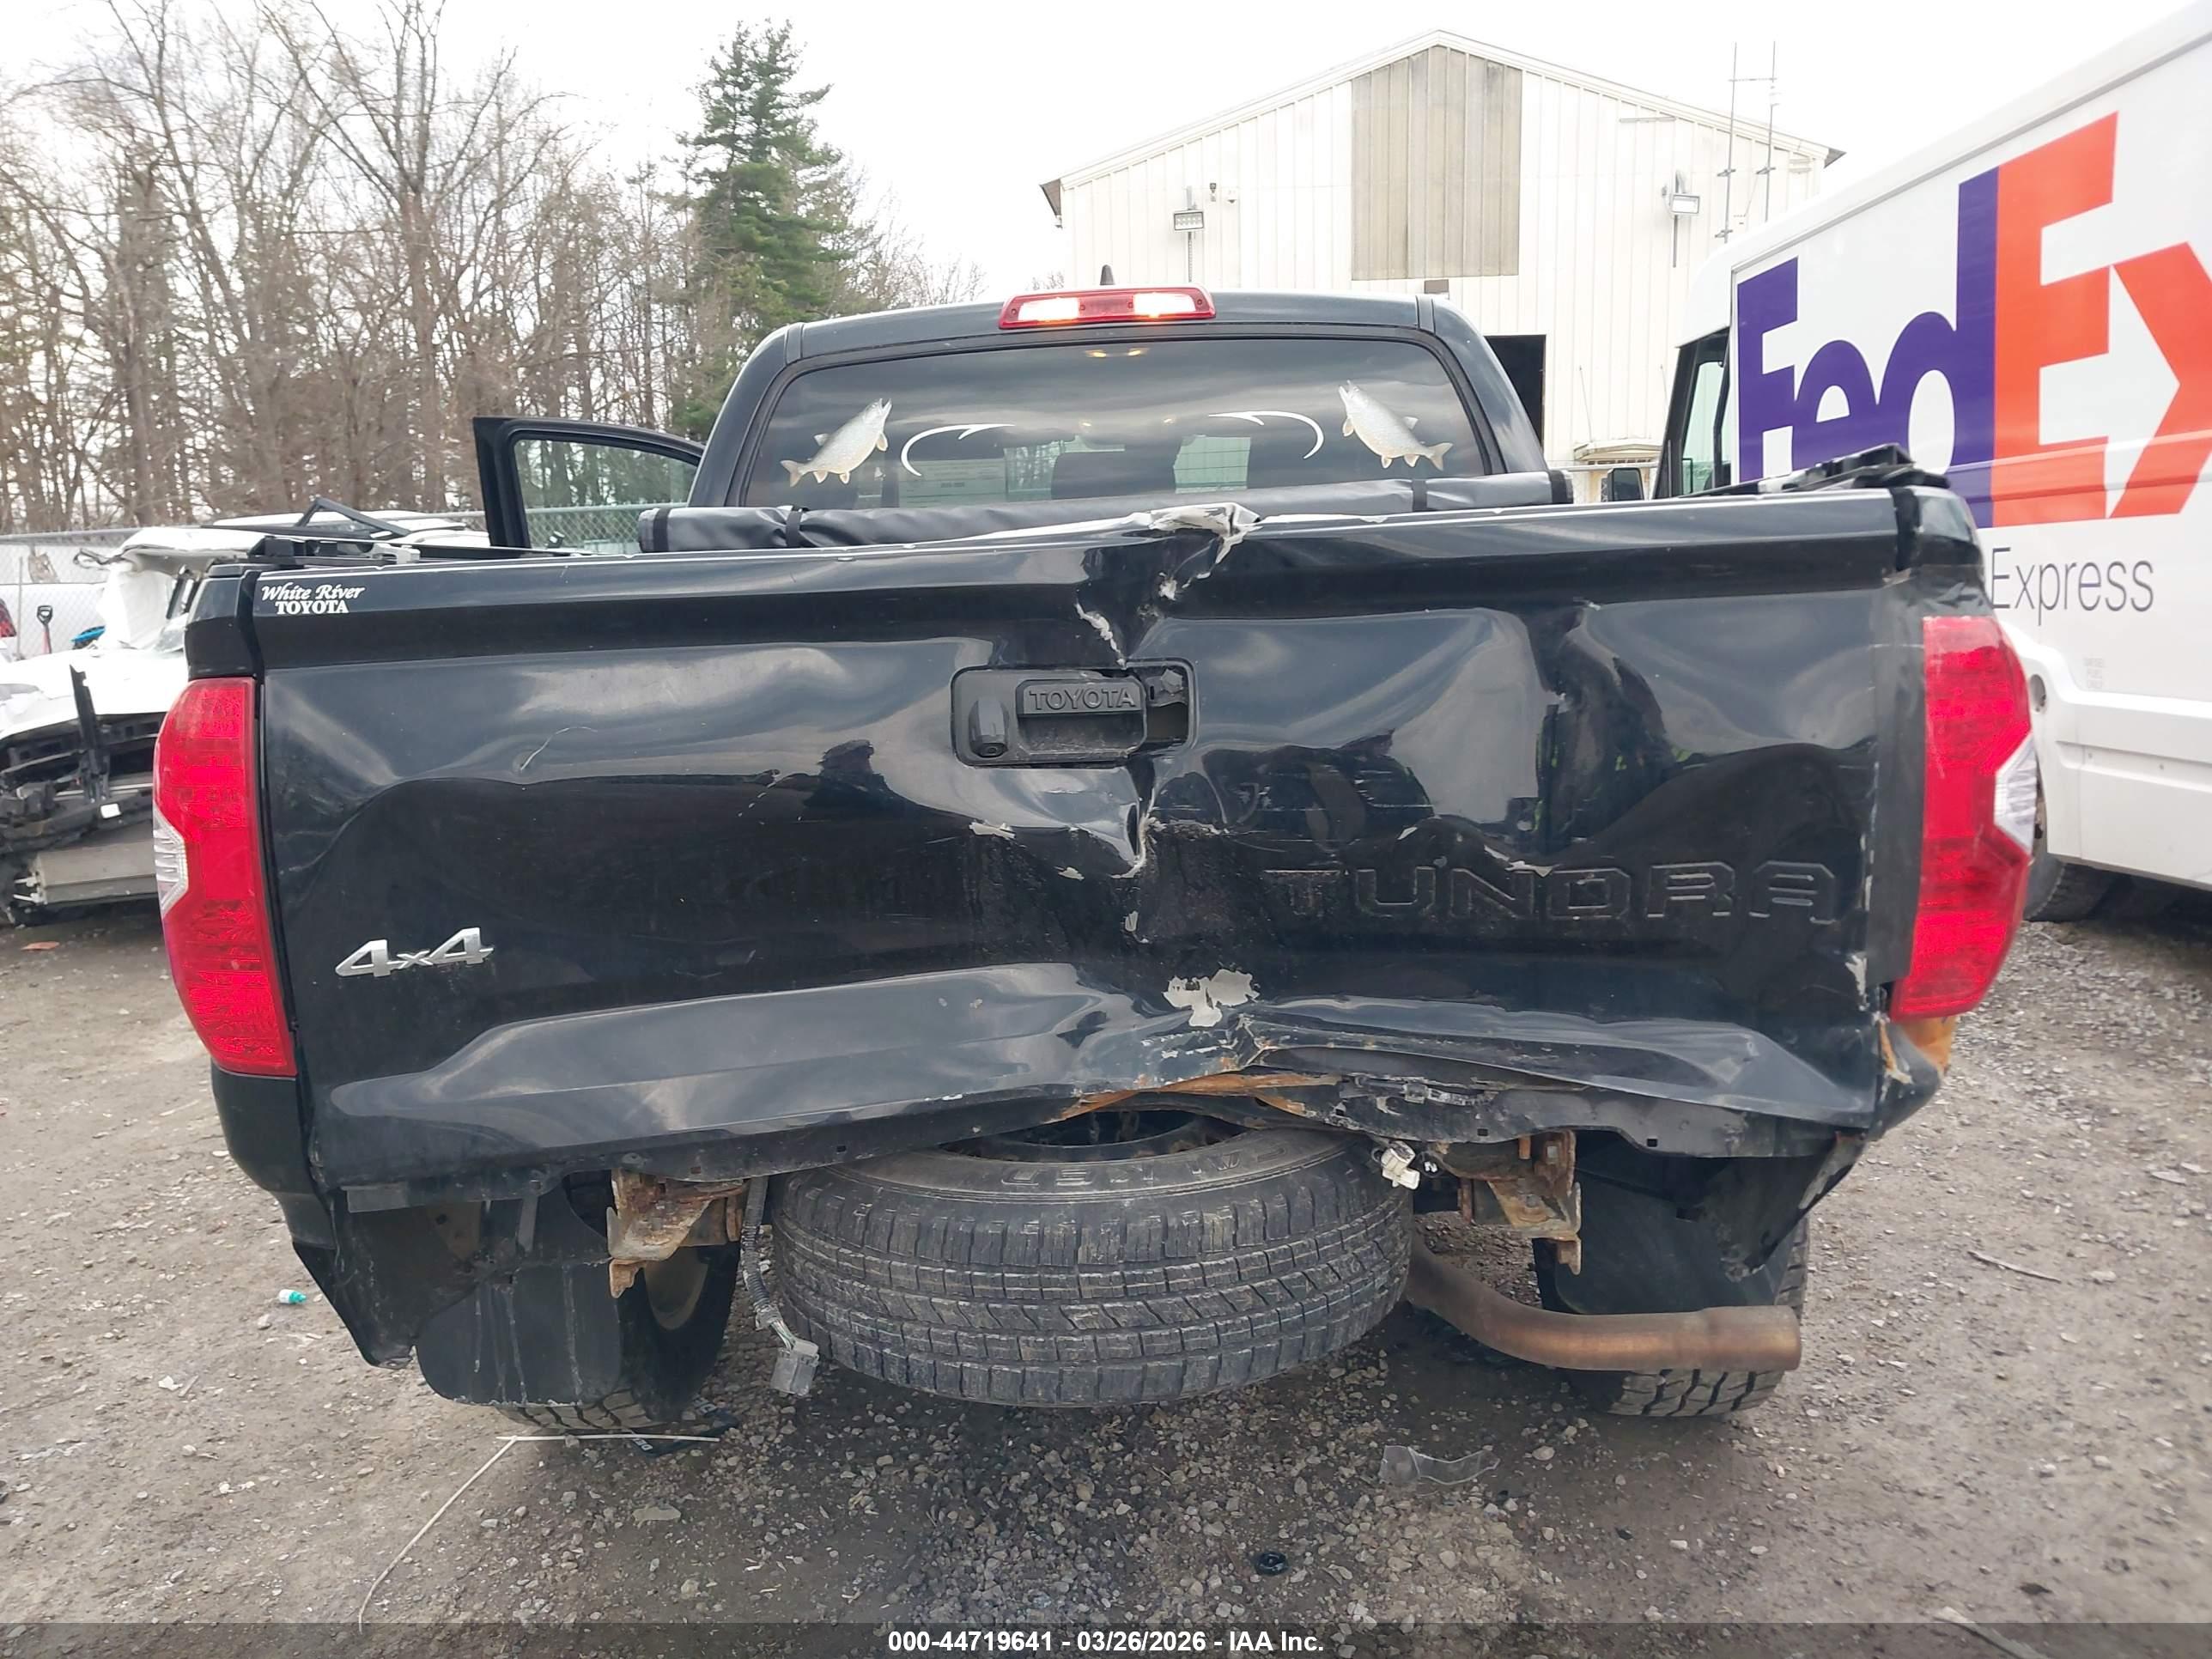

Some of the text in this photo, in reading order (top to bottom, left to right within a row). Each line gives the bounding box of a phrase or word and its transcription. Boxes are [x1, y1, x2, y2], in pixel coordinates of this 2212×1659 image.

[1736, 110, 2212, 529] FedEx
[261, 581, 365, 601] White River
[274, 599, 349, 615] TOYOTA
[1990, 547, 2154, 626] Express
[1029, 687, 1136, 711] TOYOTA
[1262, 860, 1839, 926] TUNDRA
[335, 927, 495, 977] 4x4
